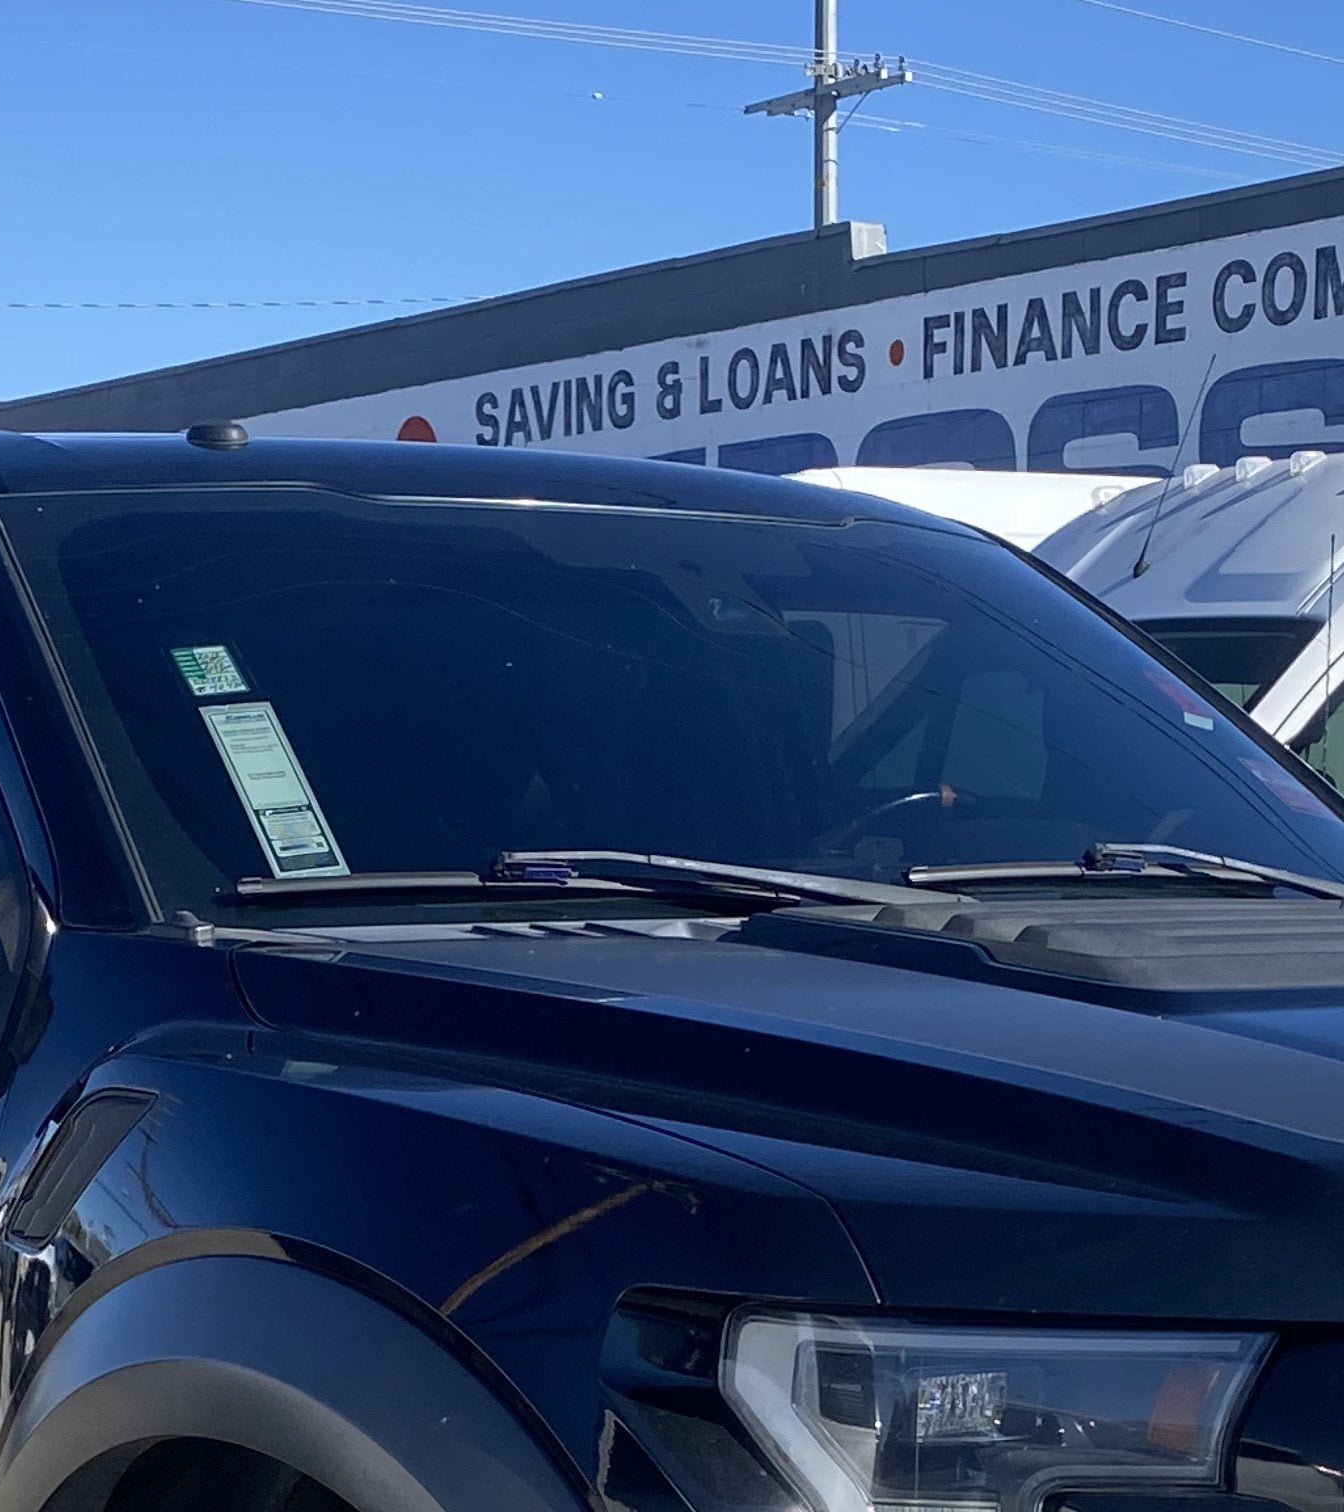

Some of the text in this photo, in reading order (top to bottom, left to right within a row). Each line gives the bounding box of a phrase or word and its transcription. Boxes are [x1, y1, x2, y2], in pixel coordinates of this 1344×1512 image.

[475, 368, 636, 448] SAVING
[656, 361, 683, 420] &
[699, 329, 866, 414] LOANS
[922, 272, 1188, 380] FINANCE
